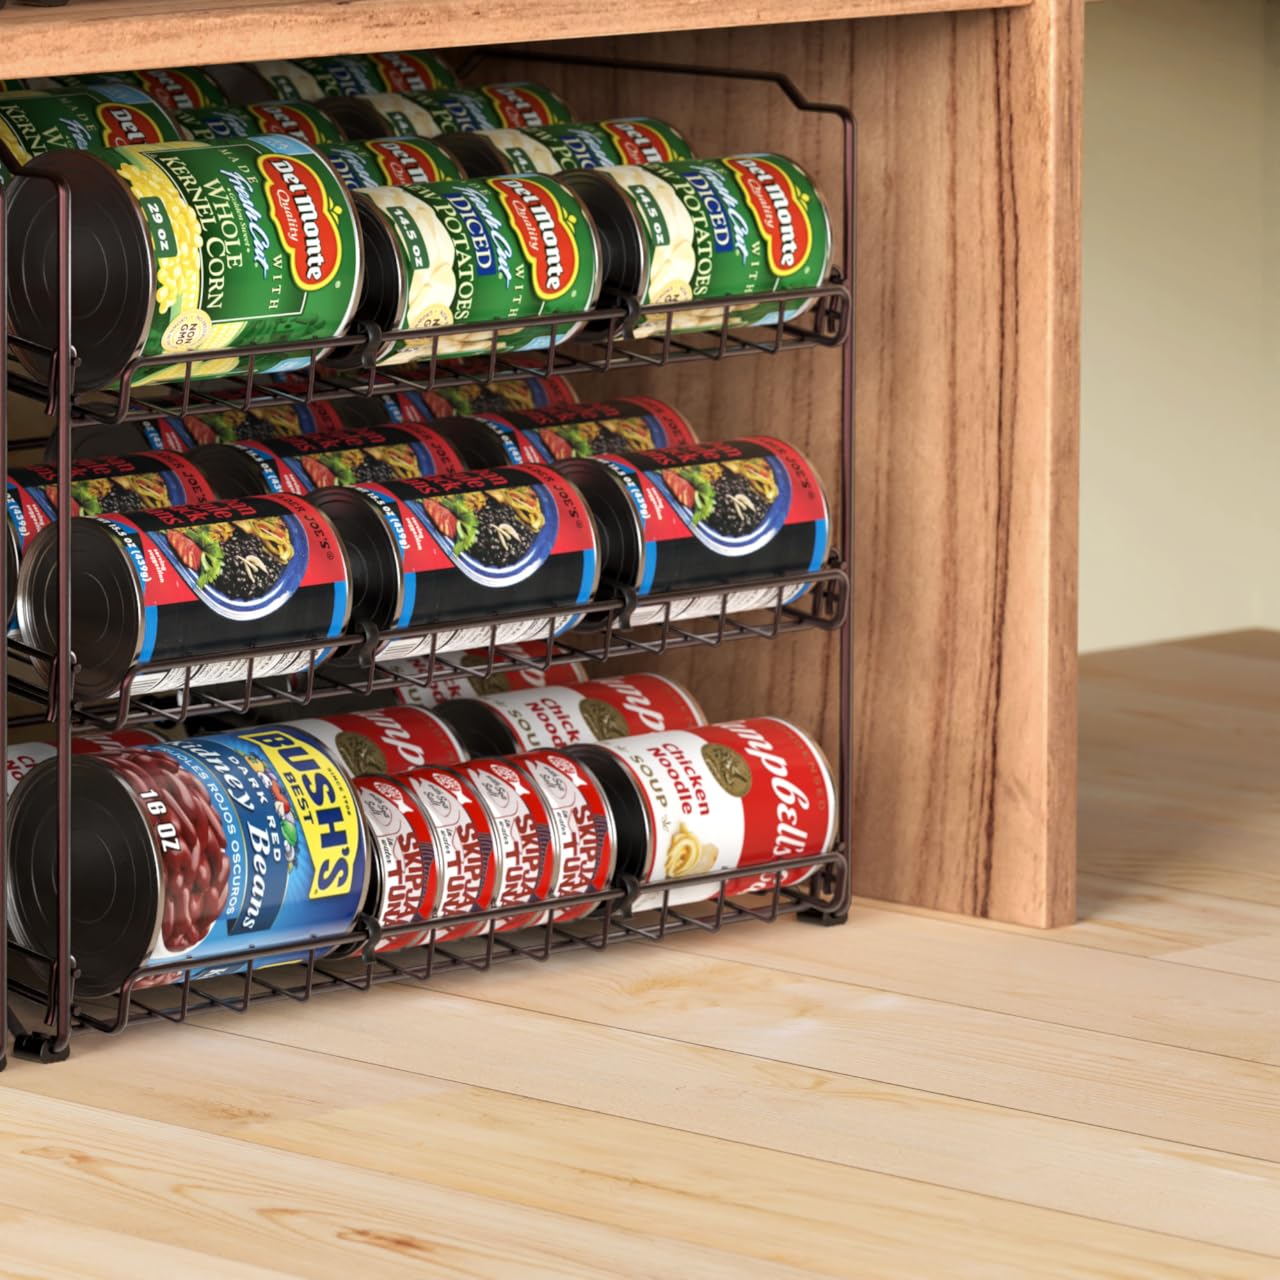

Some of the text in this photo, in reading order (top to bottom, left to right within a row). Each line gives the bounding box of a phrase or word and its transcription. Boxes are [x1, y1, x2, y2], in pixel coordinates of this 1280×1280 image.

[148, 203, 169, 252] 29 OZ
[161, 156, 225, 309] KERNEL CORN
[203, 178, 243, 269] WHOLE
[271, 159, 326, 281] Del Monte
[277, 188, 301, 243] Quality
[393, 208, 424, 267] 14.5 OZ
[449, 195, 493, 269] DICED
[512, 199, 540, 252] Quality
[635, 187, 665, 244] 14.5 OZ
[672, 182, 713, 296] POTATOES
[686, 173, 730, 246] DICED
[765, 183, 797, 267] Monte
[268, 254, 283, 310] WITH
[435, 203, 475, 320] POTATOES
[530, 205, 564, 290] Monte
[228, 756, 282, 862] DARK RED
[258, 733, 350, 892] BUSH'S
[283, 772, 314, 824] BEST
[630, 755, 668, 808] SOUP
[647, 747, 693, 815] Noodle
[662, 743, 710, 816] Chicken
[138, 789, 181, 853] 16 OZ
[207, 783, 240, 915] ROJOS OSCUROS
[241, 822, 270, 930] Beans
